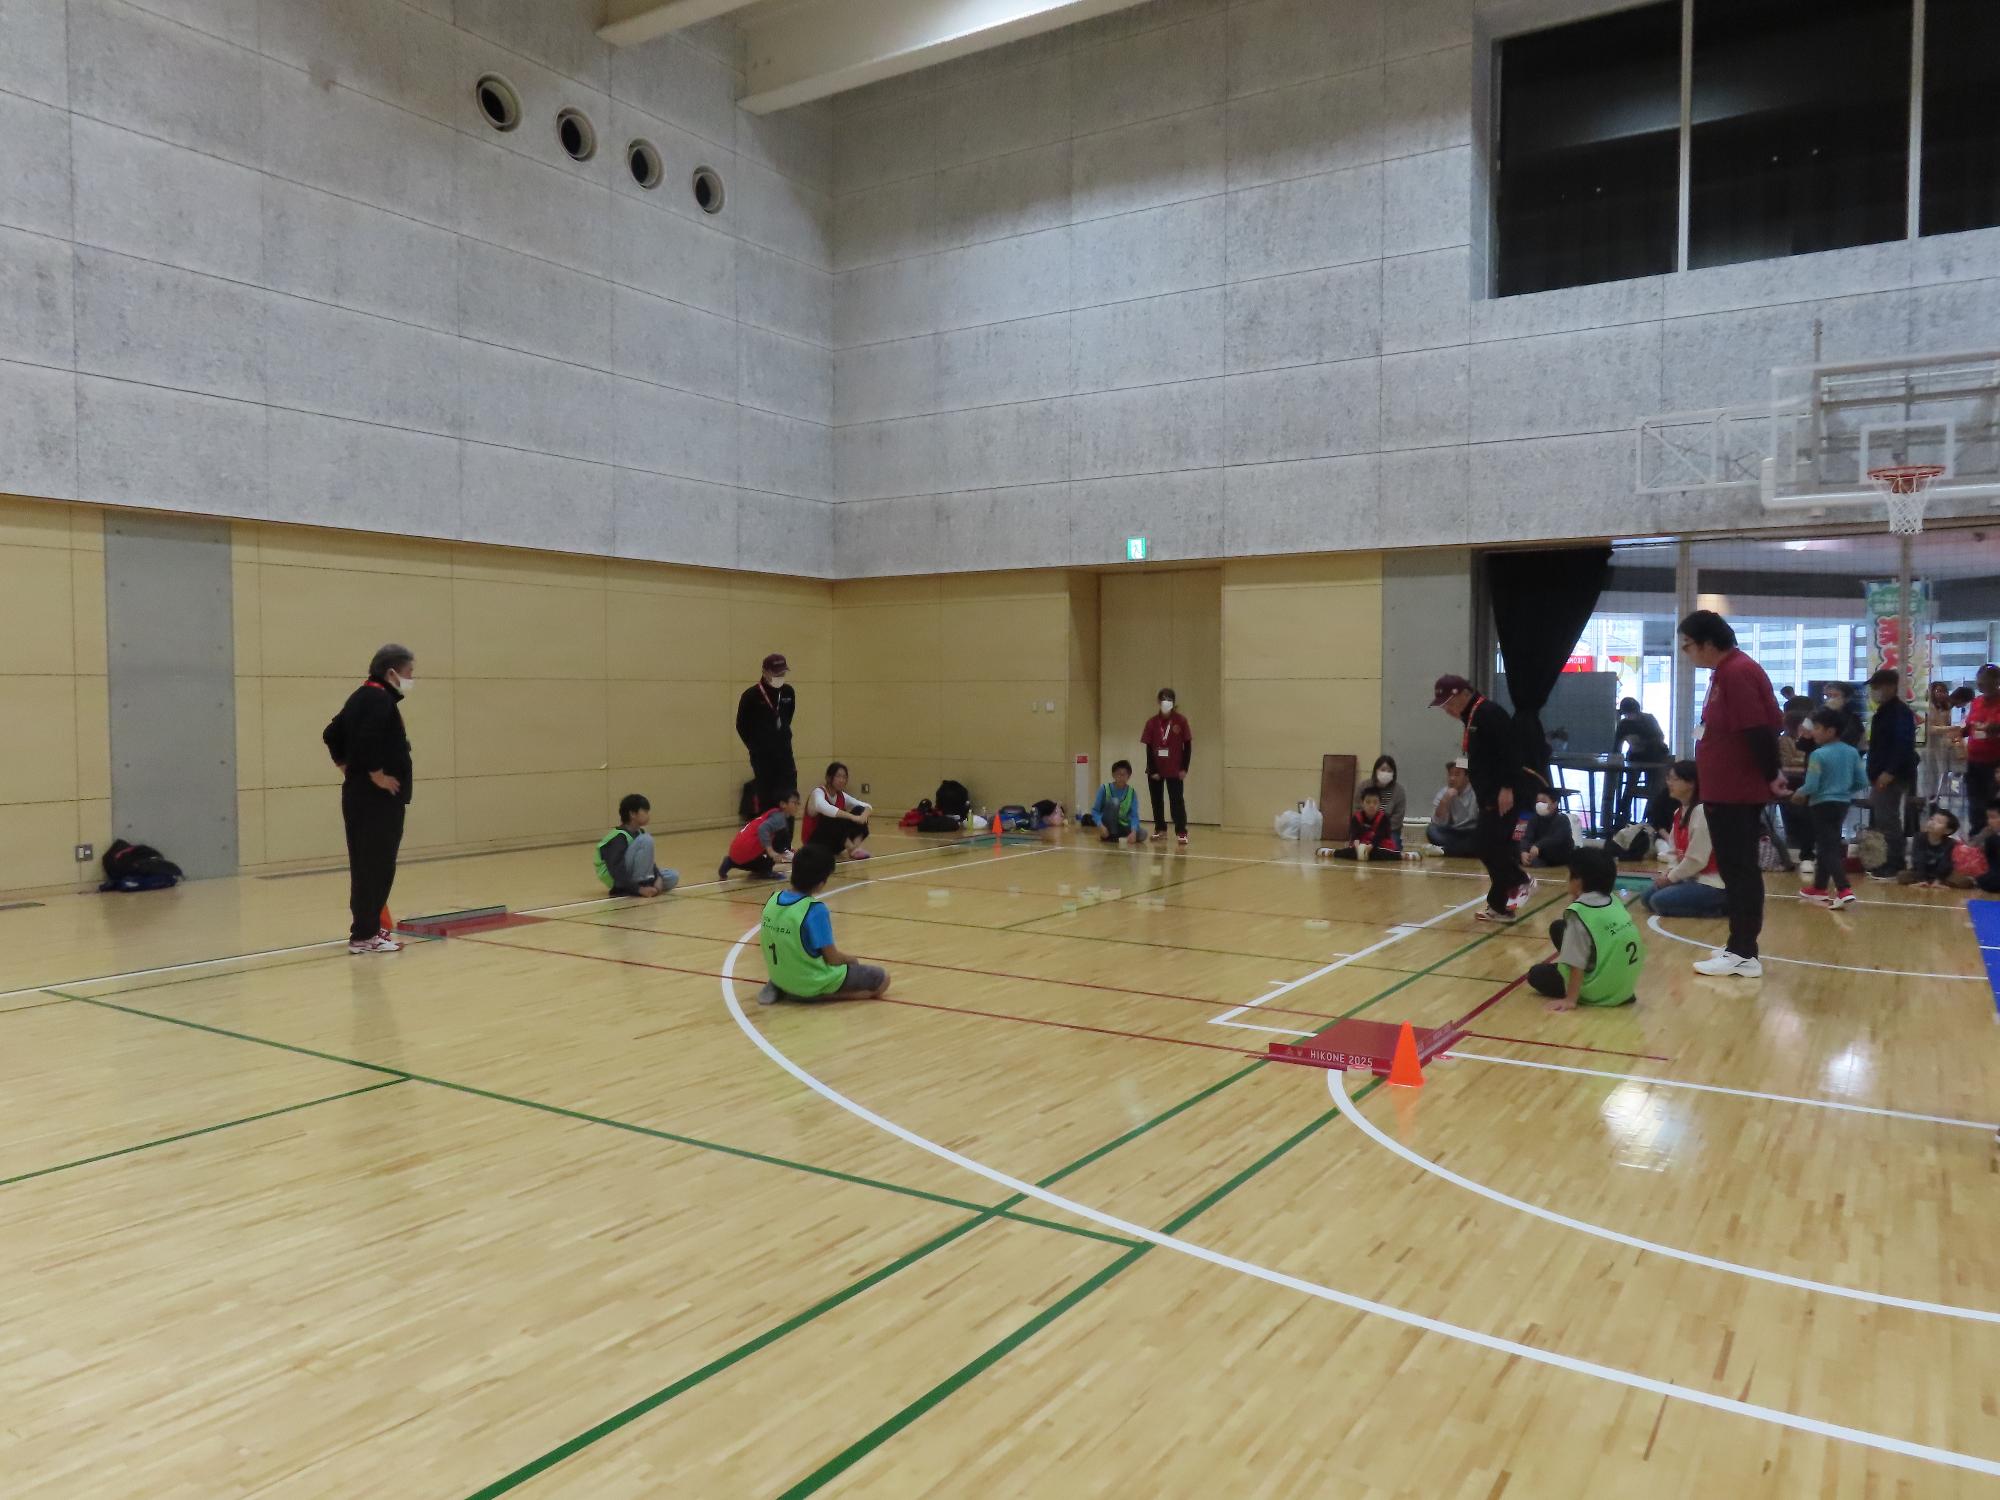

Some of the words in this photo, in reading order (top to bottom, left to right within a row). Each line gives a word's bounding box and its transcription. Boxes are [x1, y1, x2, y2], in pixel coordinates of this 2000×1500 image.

[768, 942, 778, 965] 1
[1625, 941, 1638, 965] 2
[1310, 1049, 1345, 1064] HIKONE
[1348, 1055, 1373, 1067] 2025
